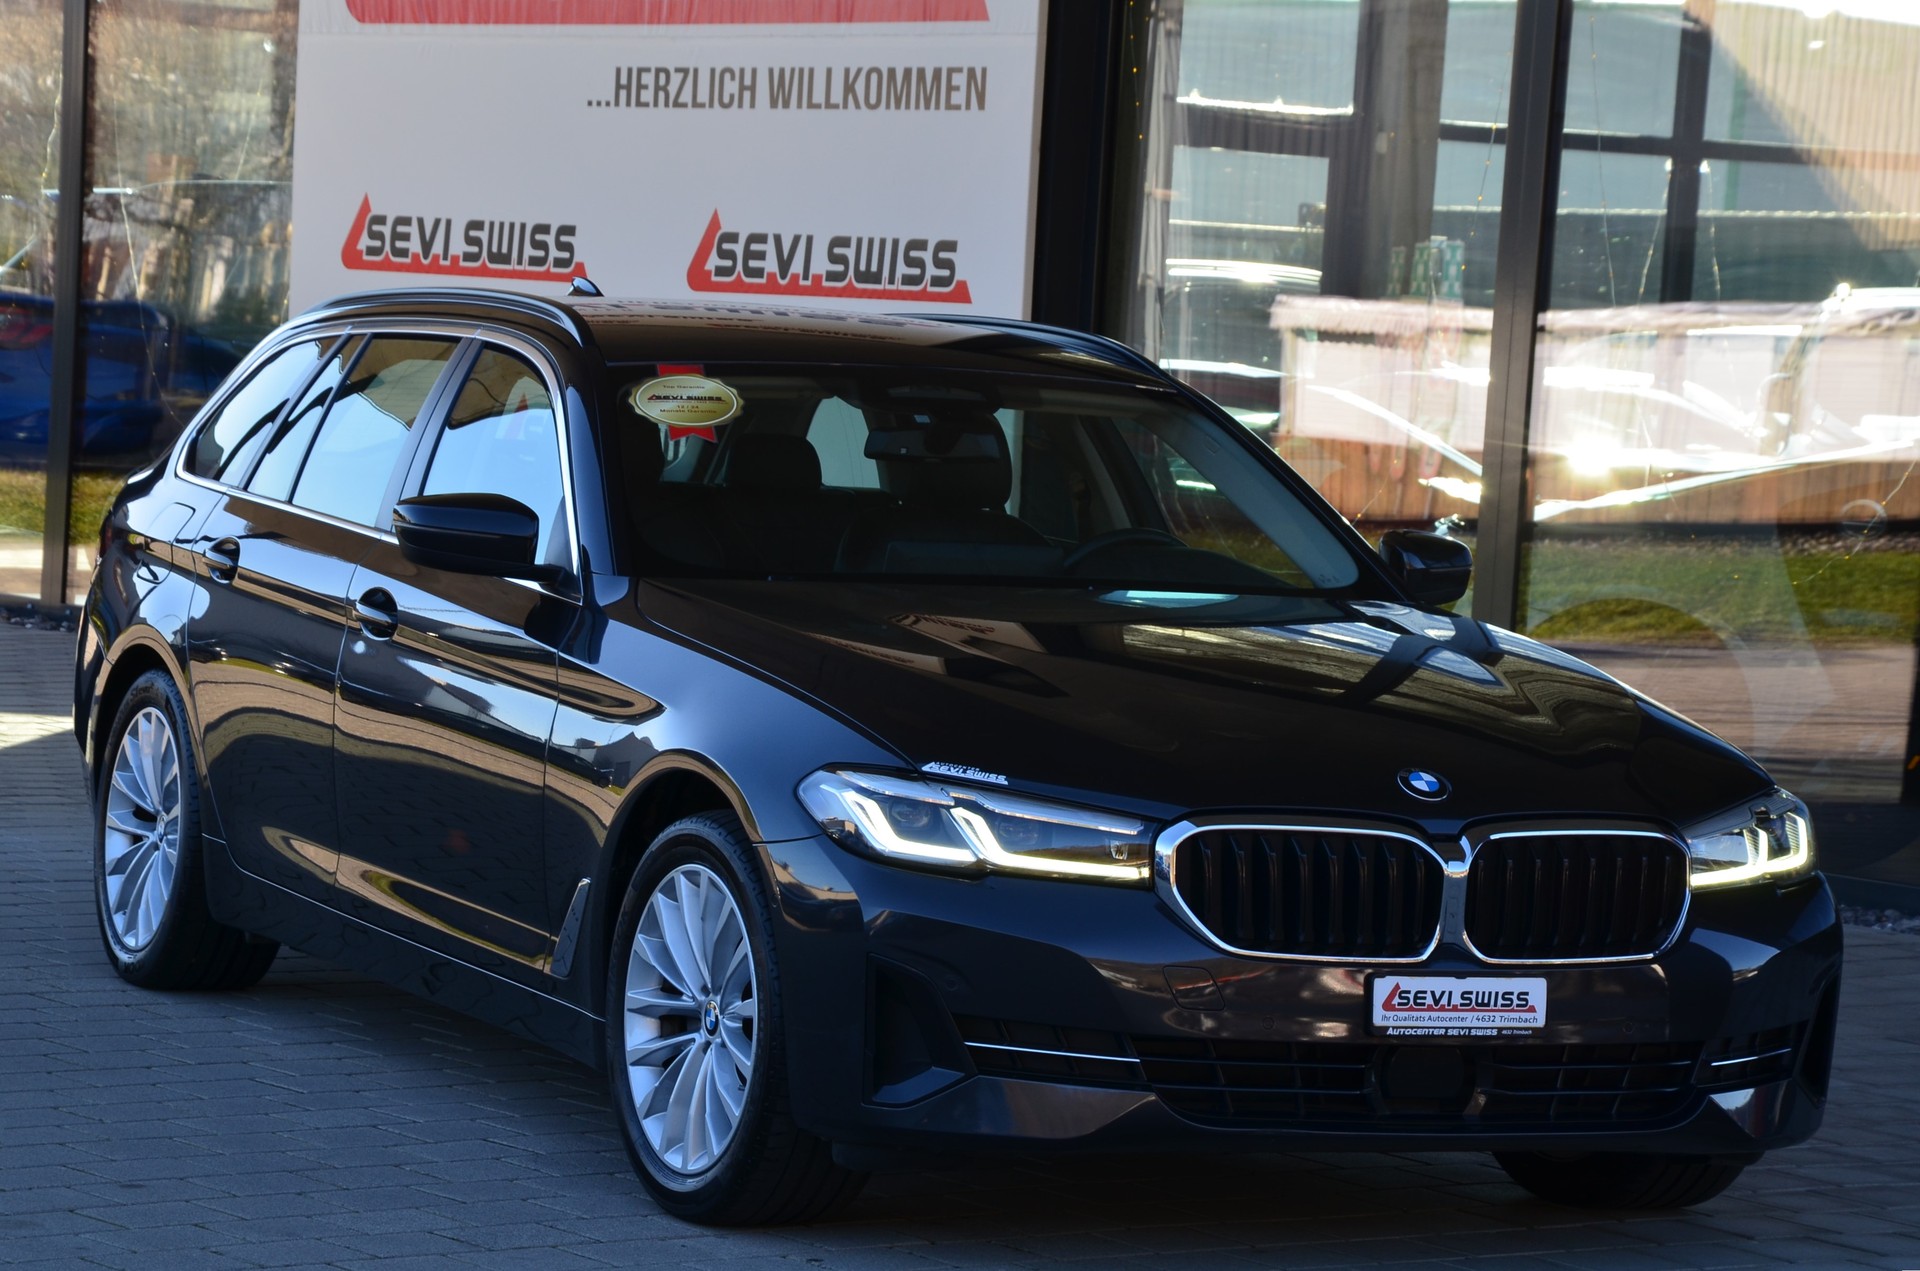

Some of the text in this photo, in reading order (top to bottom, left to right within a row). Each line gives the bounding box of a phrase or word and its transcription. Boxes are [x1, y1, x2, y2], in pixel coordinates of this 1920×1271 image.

[587, 66, 988, 112] ...HERZLICH WILLKOMMEN
[462, 219, 577, 270] SWISS
[824, 235, 958, 288] SWISS
[966, 770, 1006, 782] SWISS
[1397, 989, 1530, 1008] SEVI SWISS
[1381, 1014, 1391, 1022] Ihr
[1427, 1014, 1468, 1023] Autocenter
[1475, 1014, 1497, 1023] 4632
[1499, 1015, 1538, 1024] Trimbach
[1447, 1028, 1469, 1036] SEVI
[1470, 1028, 1498, 1036] SWISS
